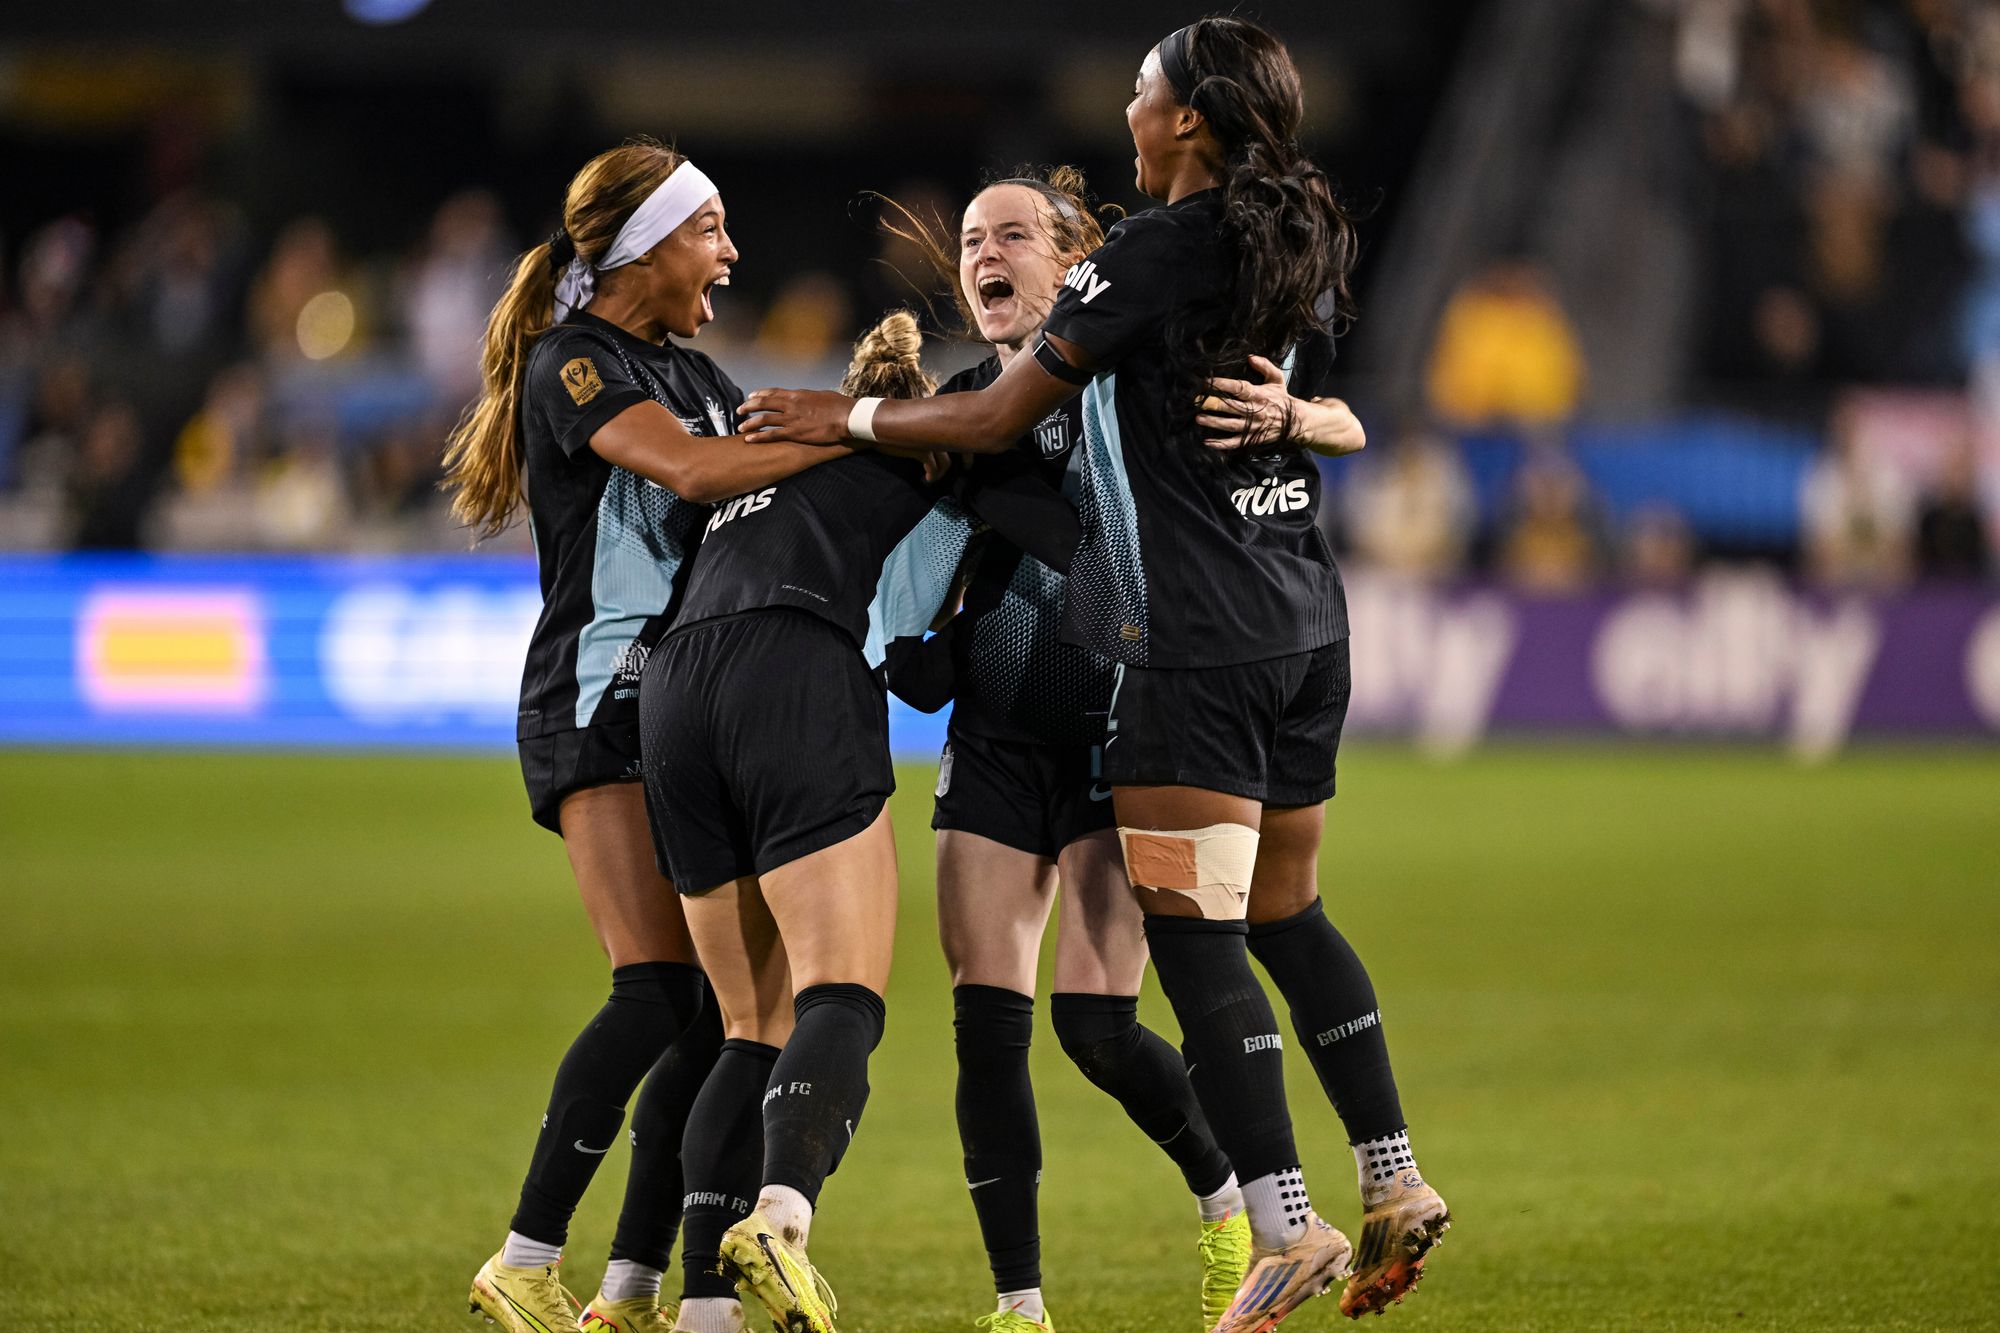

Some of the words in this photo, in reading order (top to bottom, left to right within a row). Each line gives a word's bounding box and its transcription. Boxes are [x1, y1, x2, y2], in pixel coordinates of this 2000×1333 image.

[1040, 425, 1064, 454] NY
[1316, 1011, 1377, 1047] GOTHAM
[788, 1081, 812, 1096] FC
[683, 1191, 727, 1212] OTHAM
[730, 1196, 748, 1214] FC
